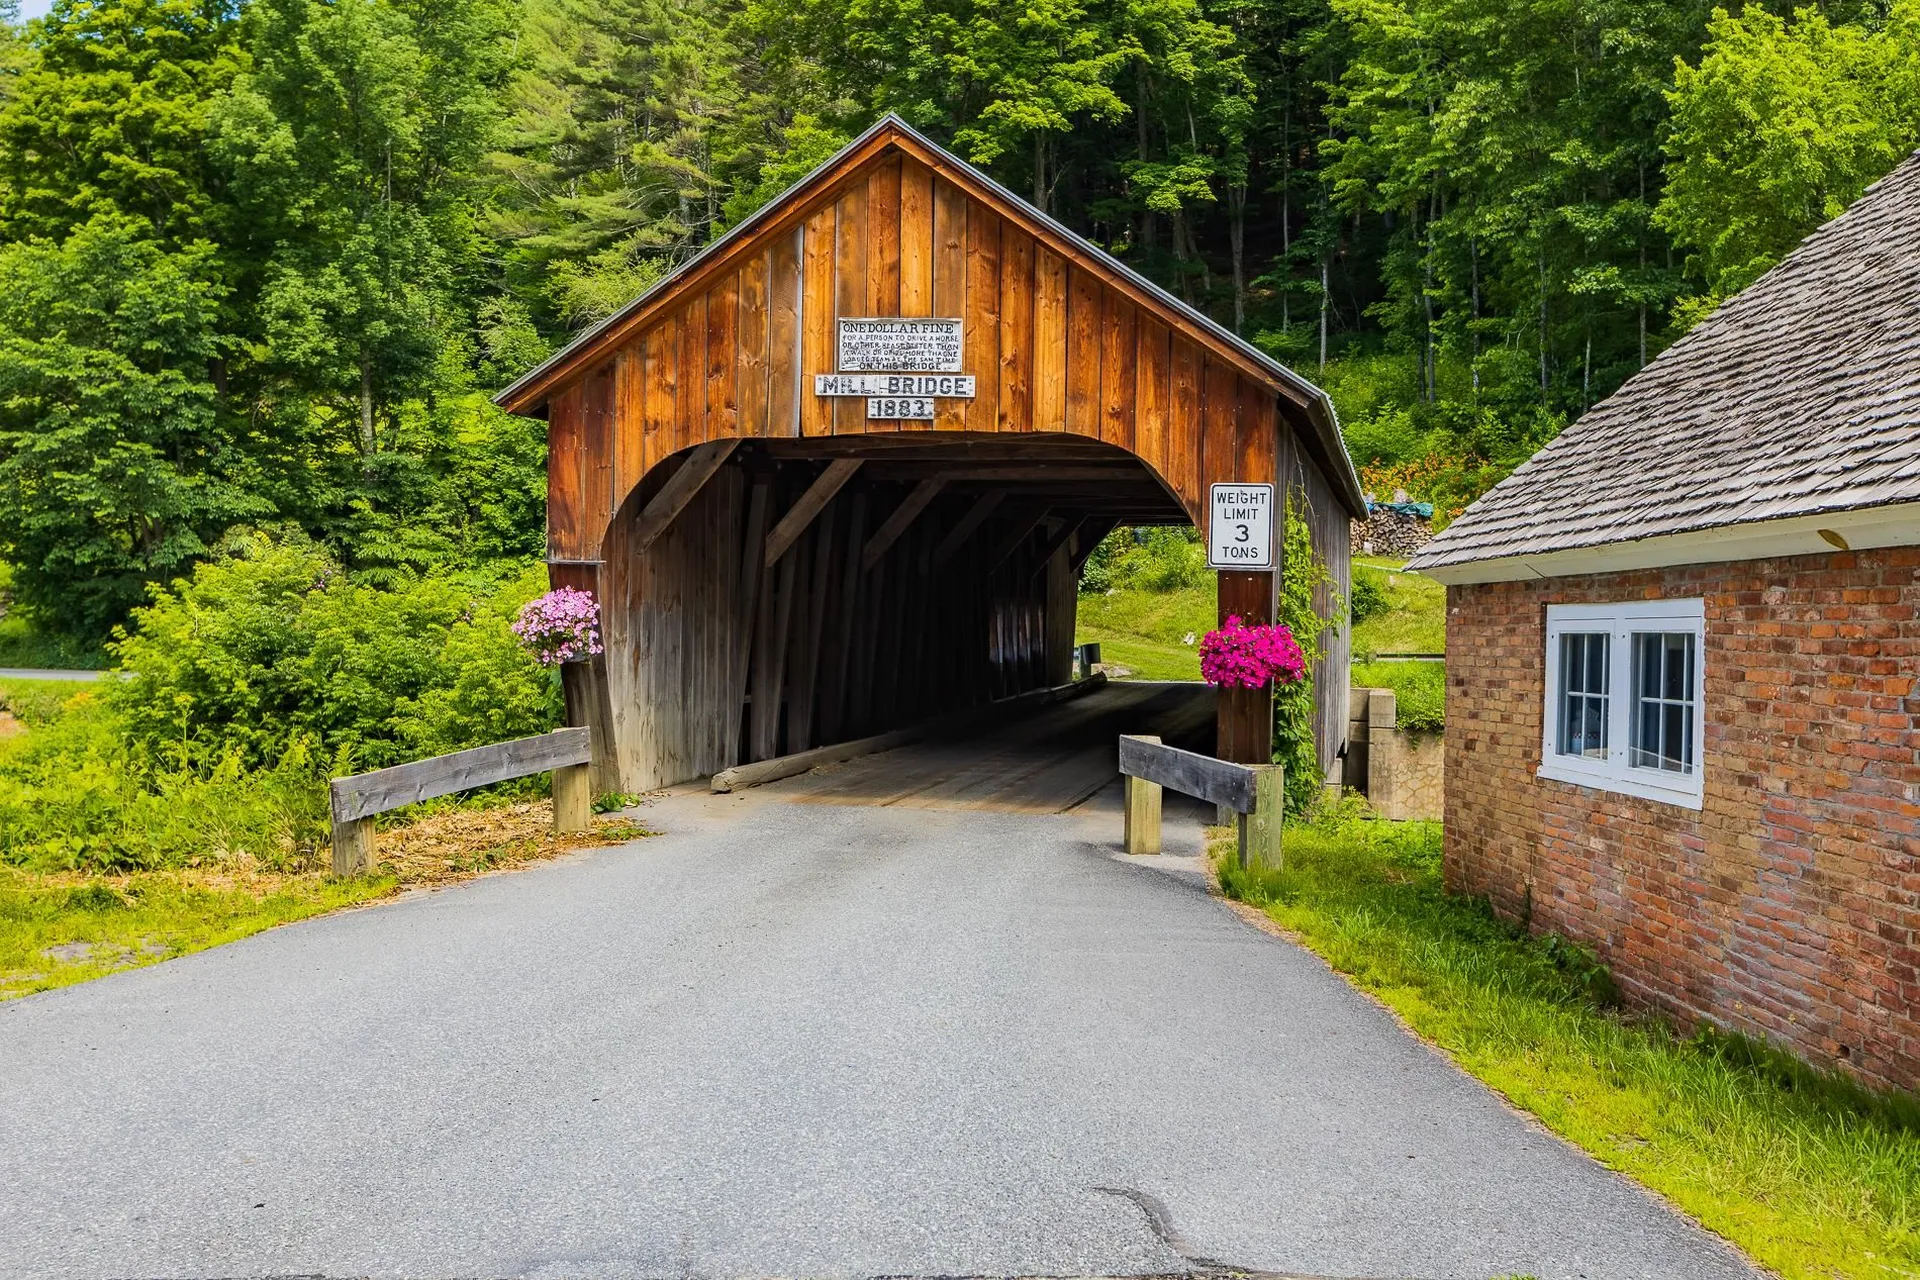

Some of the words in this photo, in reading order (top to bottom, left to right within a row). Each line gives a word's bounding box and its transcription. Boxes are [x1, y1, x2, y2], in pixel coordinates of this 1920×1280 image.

[843, 323, 866, 333] ONE
[868, 323, 919, 334] DOLLAR
[922, 323, 954, 334] FINE
[859, 362, 873, 370] ON
[875, 362, 899, 370] THIS
[902, 362, 941, 370] BRIDGE
[822, 376, 872, 394] MILL
[888, 376, 968, 395] BRIDGE
[876, 399, 925, 417] 1883
[1217, 492, 1267, 505] WEIGHT
[1224, 508, 1259, 520] LIMIT
[1235, 524, 1249, 542] 3
[1222, 546, 1258, 559] TONS
